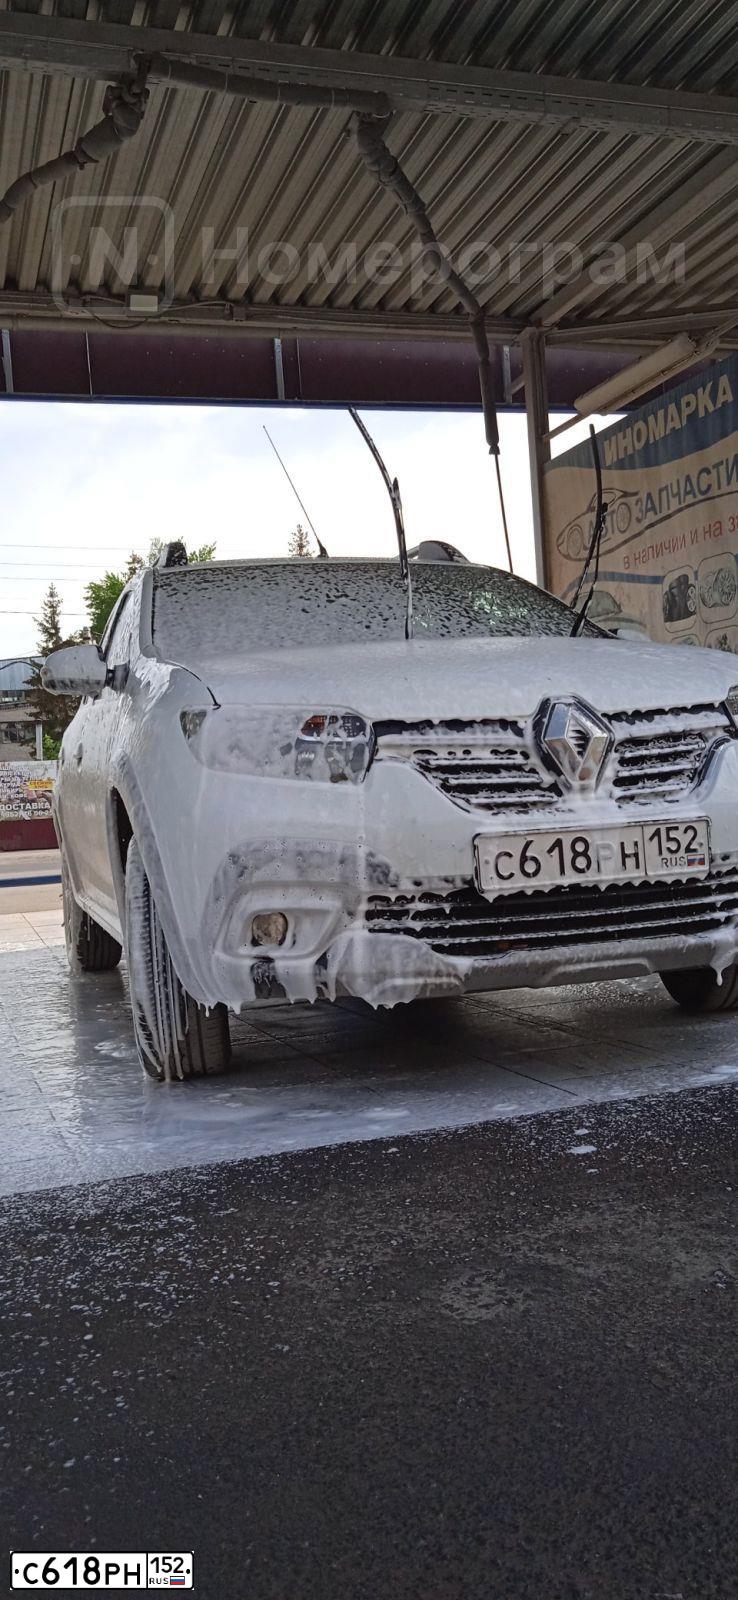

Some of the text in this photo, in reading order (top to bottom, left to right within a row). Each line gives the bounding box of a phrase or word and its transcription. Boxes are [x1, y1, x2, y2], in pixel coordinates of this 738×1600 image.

[603, 374, 734, 467] ИНОМАРКА
[633, 534, 687, 565] наличии
[690, 529, 699, 544] и
[703, 520, 723, 541] на
[727, 513, 738, 533] з
[0, 802, 51, 811] ДОСТАВКА
[648, 824, 699, 855] 152
[661, 855, 687, 869] RUS
